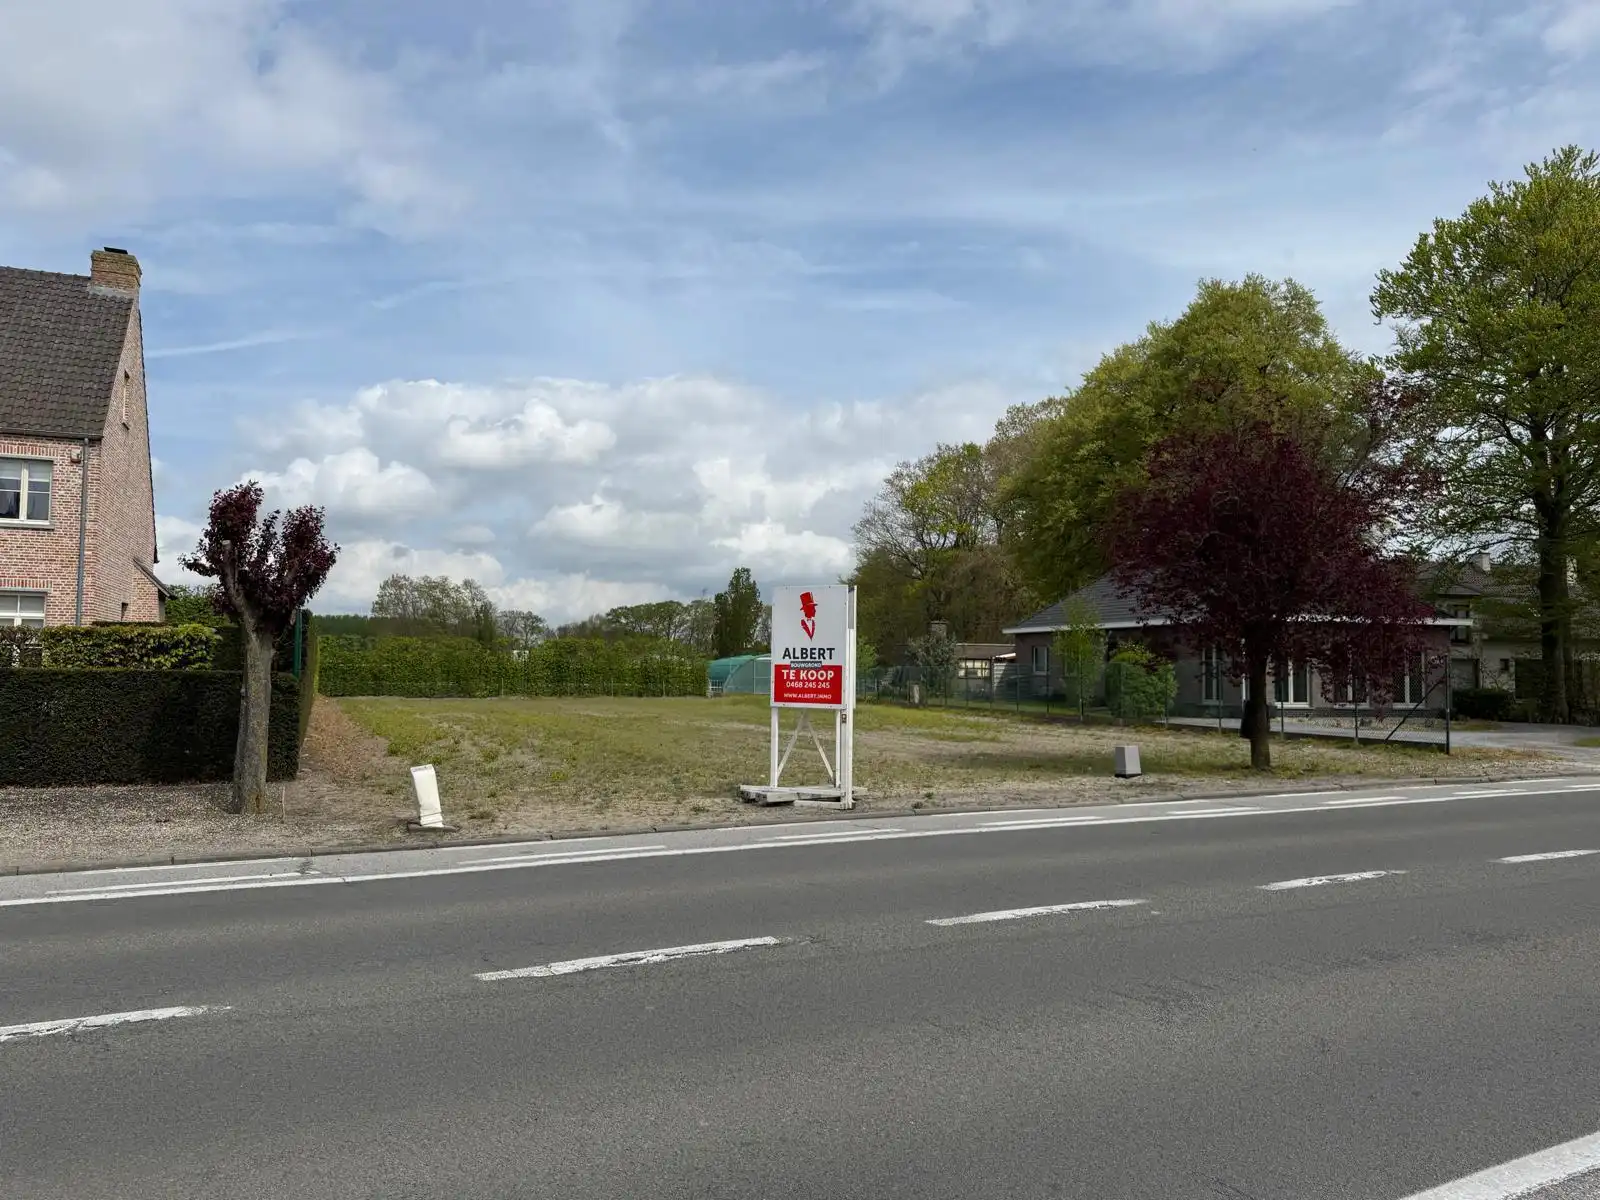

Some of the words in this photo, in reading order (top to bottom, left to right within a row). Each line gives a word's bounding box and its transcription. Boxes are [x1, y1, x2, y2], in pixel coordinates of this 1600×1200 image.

[782, 648, 836, 660] ALBERT
[782, 670, 796, 680] TE
[800, 670, 834, 680] KOOP
